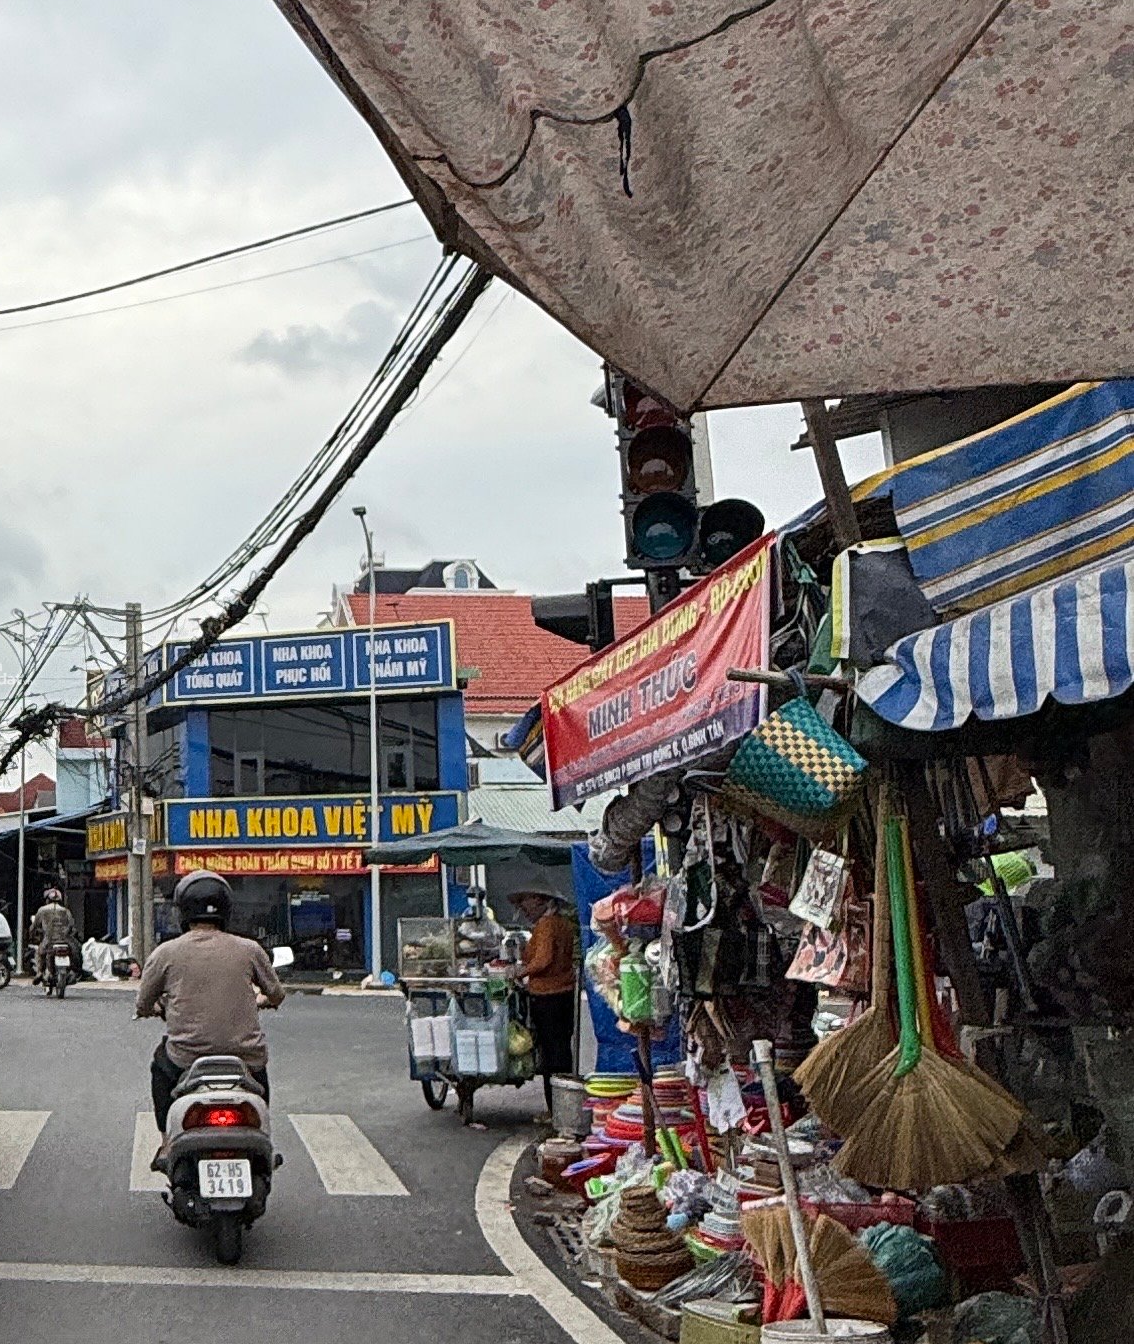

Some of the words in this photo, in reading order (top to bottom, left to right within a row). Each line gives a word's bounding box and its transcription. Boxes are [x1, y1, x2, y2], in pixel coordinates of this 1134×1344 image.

[272, 646, 298, 663] NHA
[300, 643, 333, 661] KHOA
[394, 636, 428, 654] KHOA
[211, 650, 243, 666] KHOA
[407, 657, 427, 676] MỸ
[215, 669, 244, 689] QUÁT
[276, 667, 307, 687] PHỤC
[587, 685, 633, 741] MINH
[637, 649, 699, 715] THỨC
[190, 808, 241, 839] NHA
[246, 806, 317, 838] KHOA
[391, 797, 434, 835] MỸ
[207, 1178, 244, 1195] 3419
